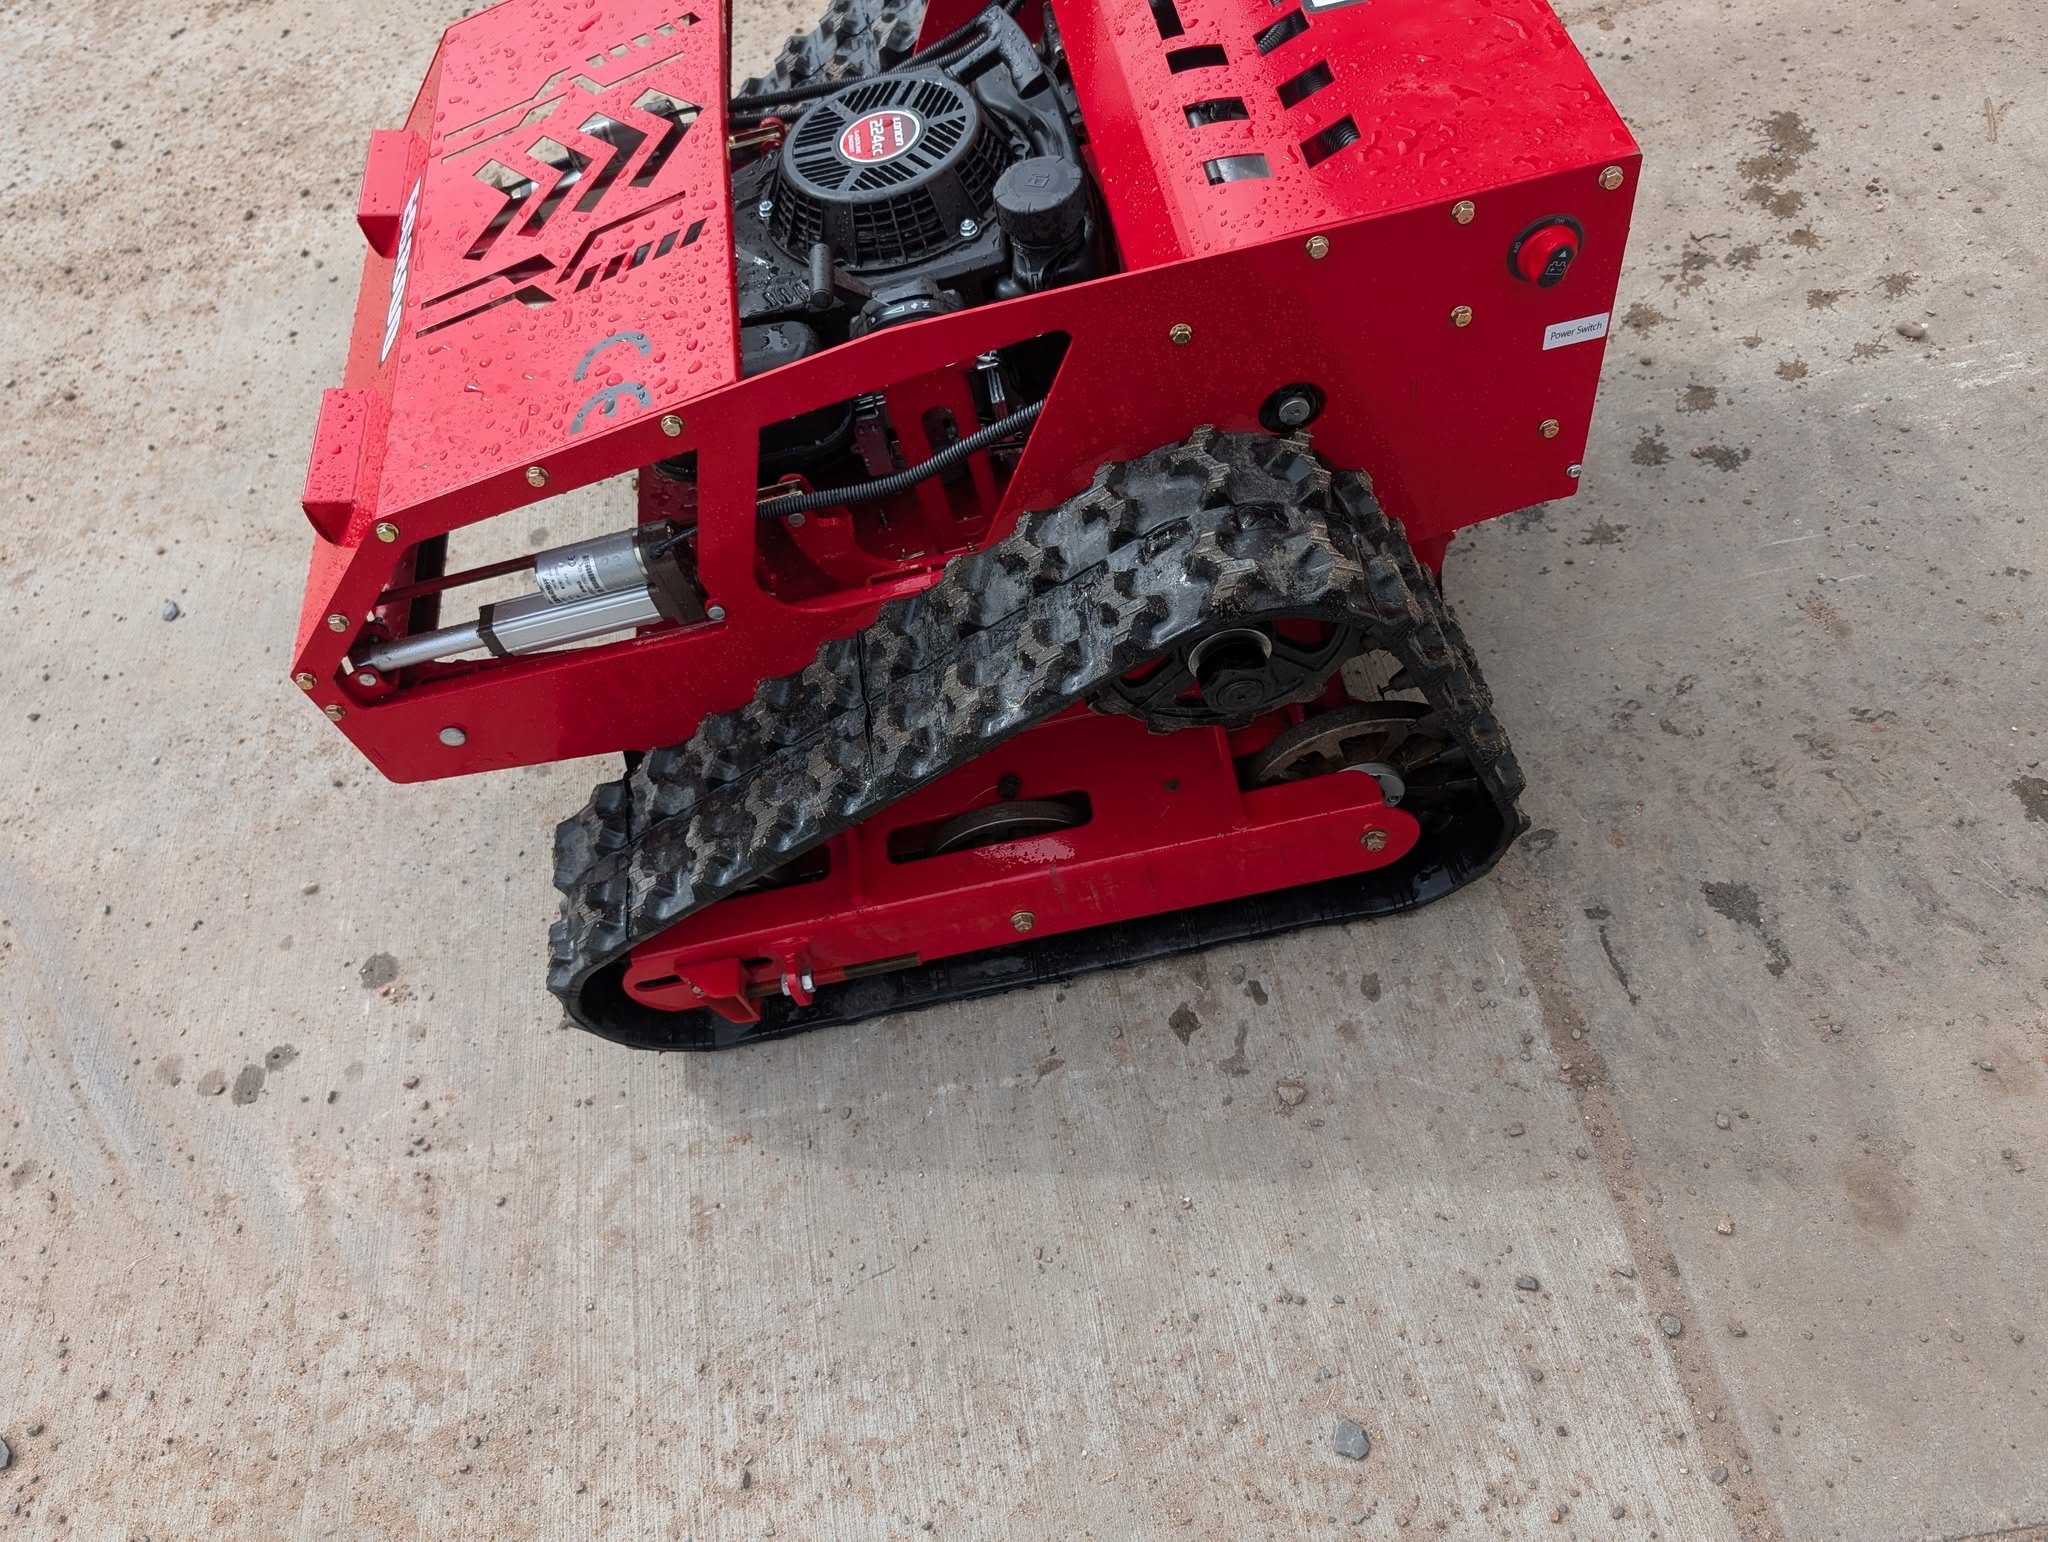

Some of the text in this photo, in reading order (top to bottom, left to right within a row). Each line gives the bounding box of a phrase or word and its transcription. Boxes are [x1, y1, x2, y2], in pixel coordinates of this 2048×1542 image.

[1550, 321, 1602, 341] Power Switch
[569, 331, 652, 435] CE
